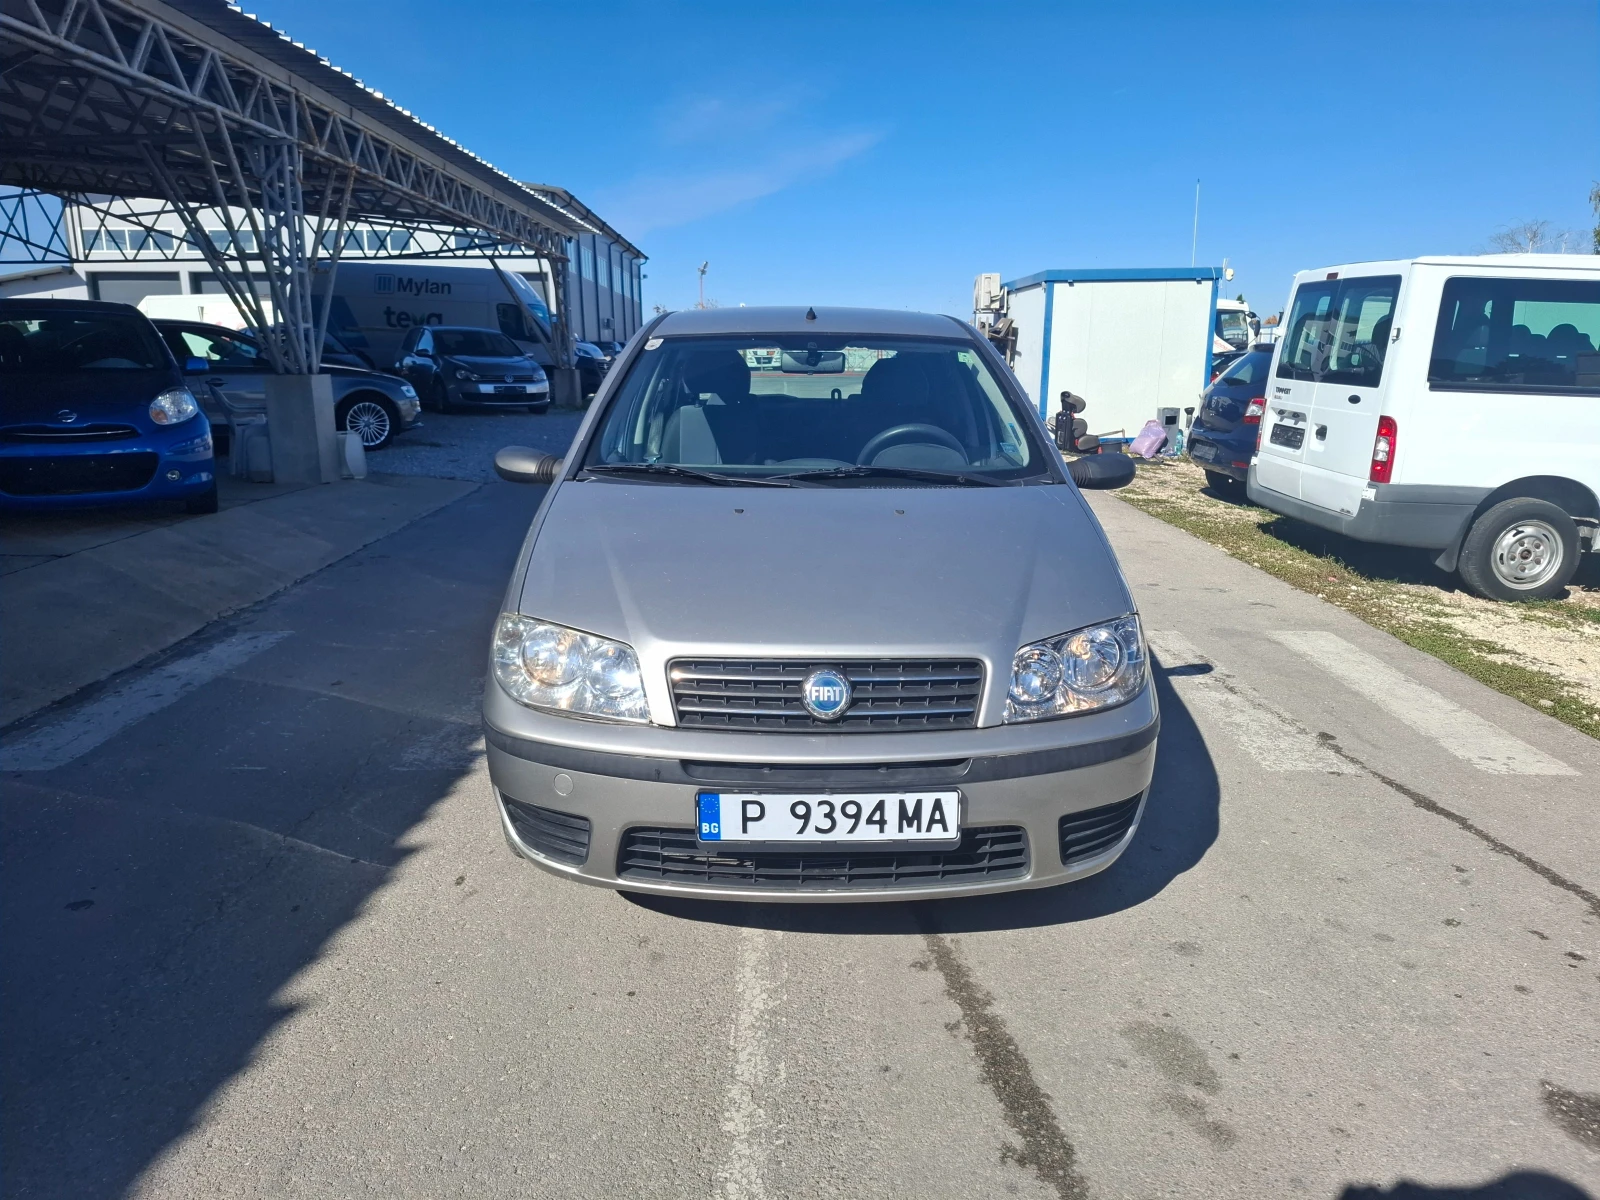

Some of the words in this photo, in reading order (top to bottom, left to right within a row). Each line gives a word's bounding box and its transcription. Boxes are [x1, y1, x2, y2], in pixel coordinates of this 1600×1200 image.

[397, 277, 452, 296] Mylan
[384, 306, 443, 328] teva
[811, 686, 842, 702] FIAT
[741, 799, 766, 834] P
[789, 799, 888, 835] 9394
[898, 798, 949, 833] MA
[701, 822, 719, 834] BG
